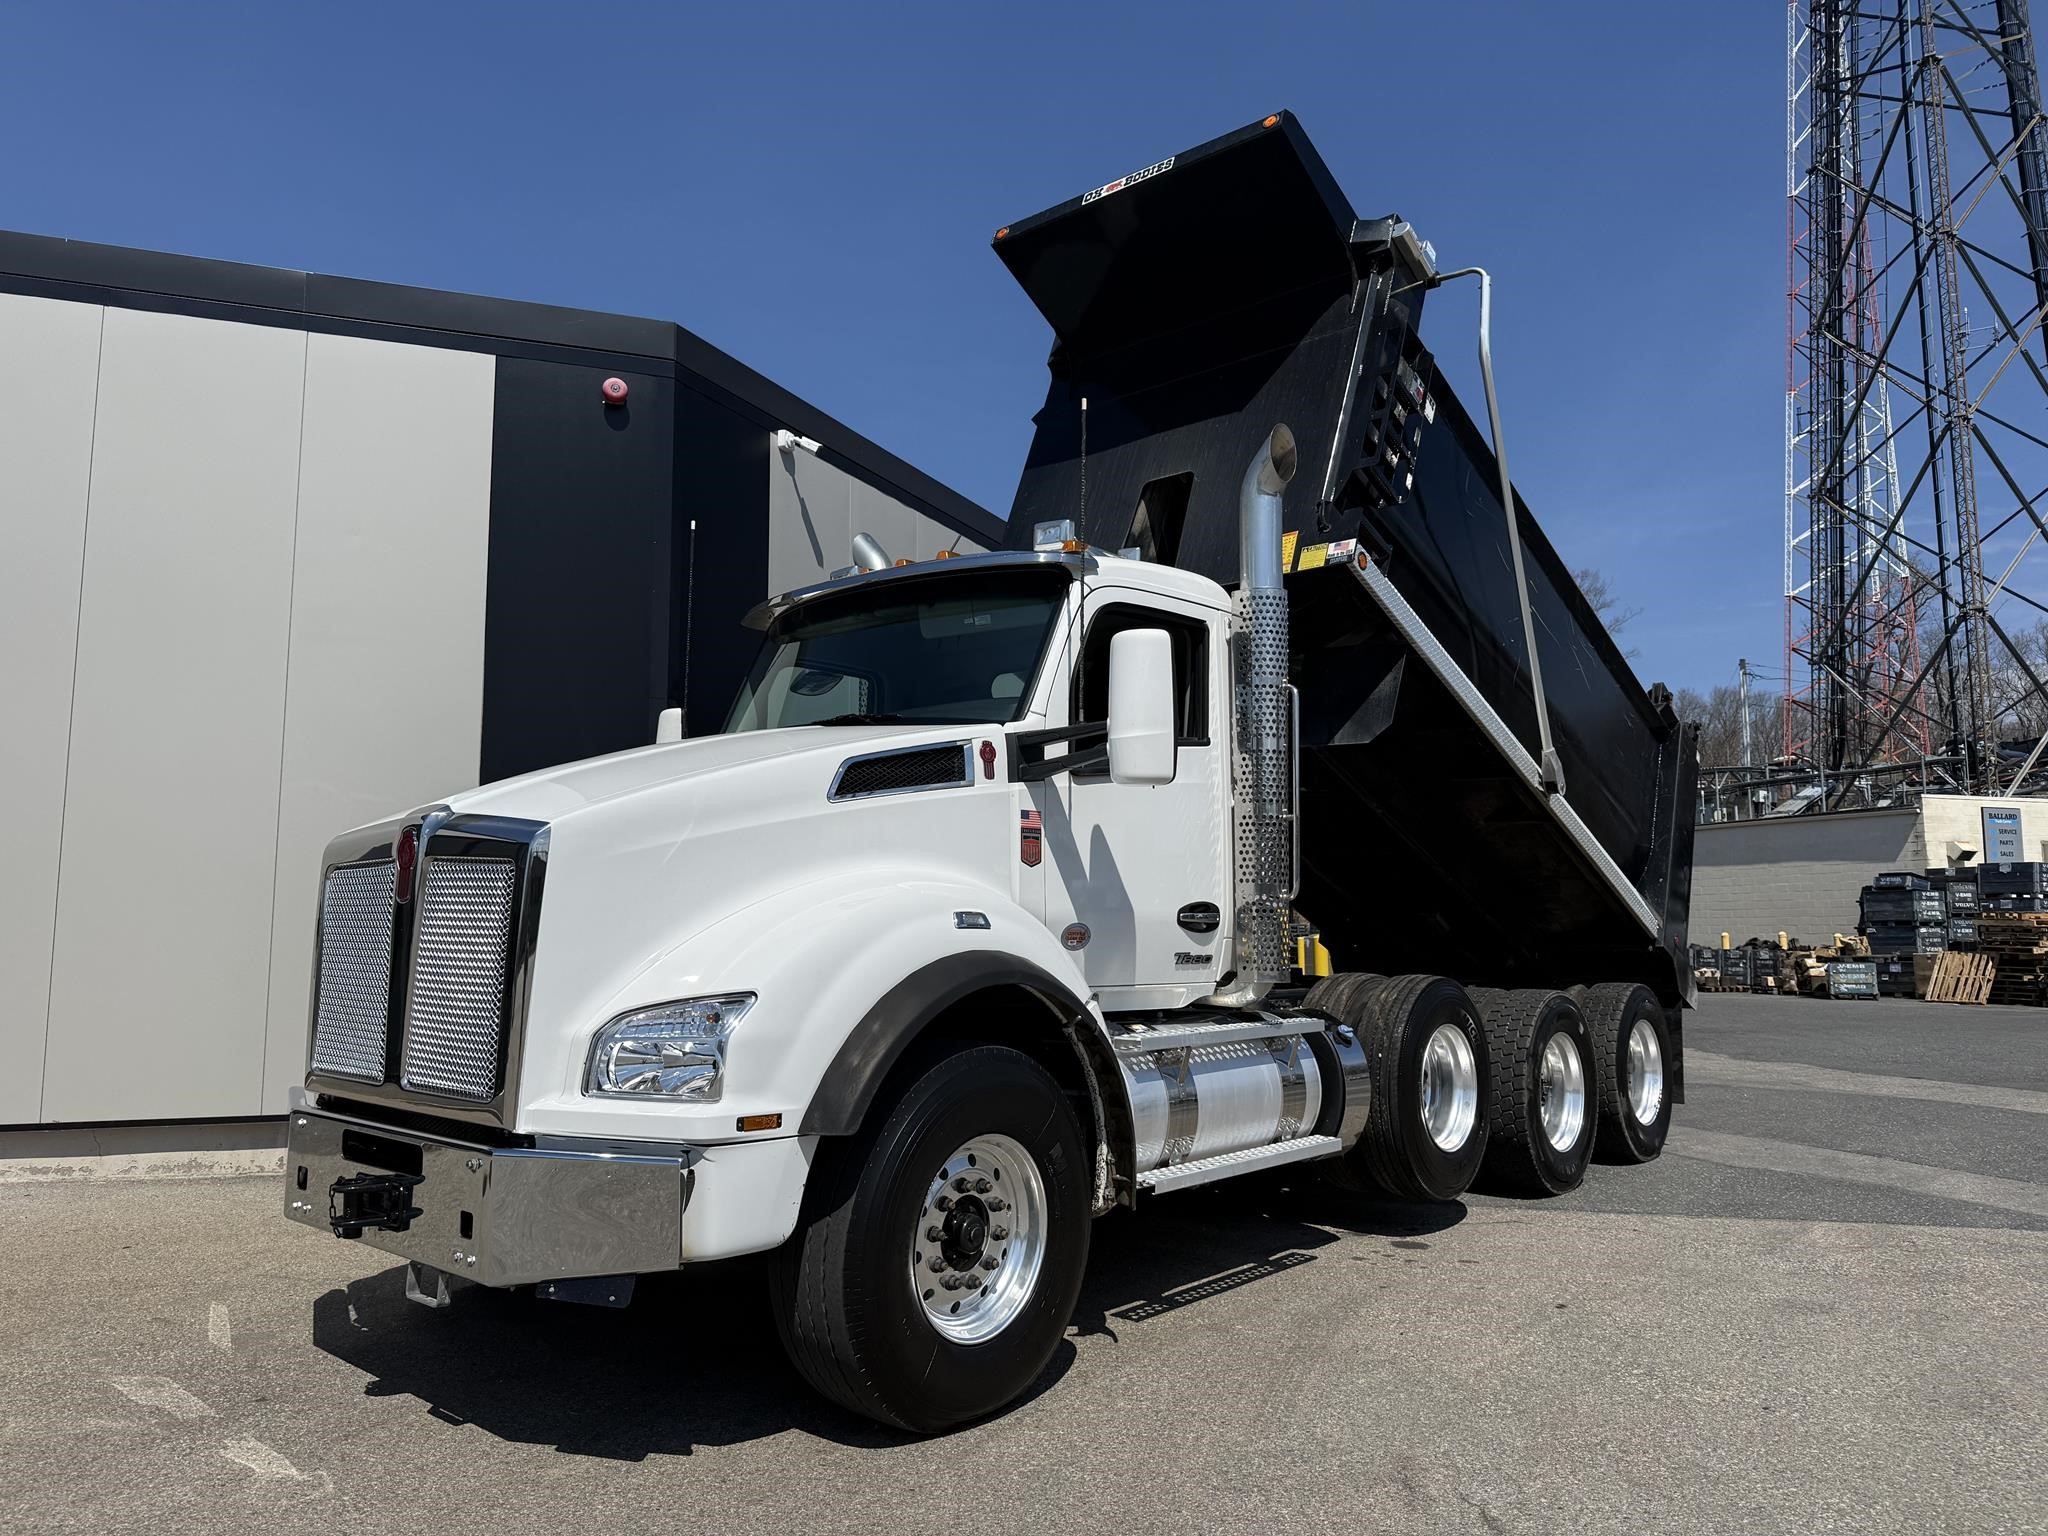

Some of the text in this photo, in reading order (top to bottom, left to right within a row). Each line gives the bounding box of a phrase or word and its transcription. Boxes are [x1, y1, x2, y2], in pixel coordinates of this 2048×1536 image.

[1083, 159, 1173, 203] OX BODIES
[1988, 812, 2017, 820] BALLARD
[1174, 952, 1213, 965] T880
